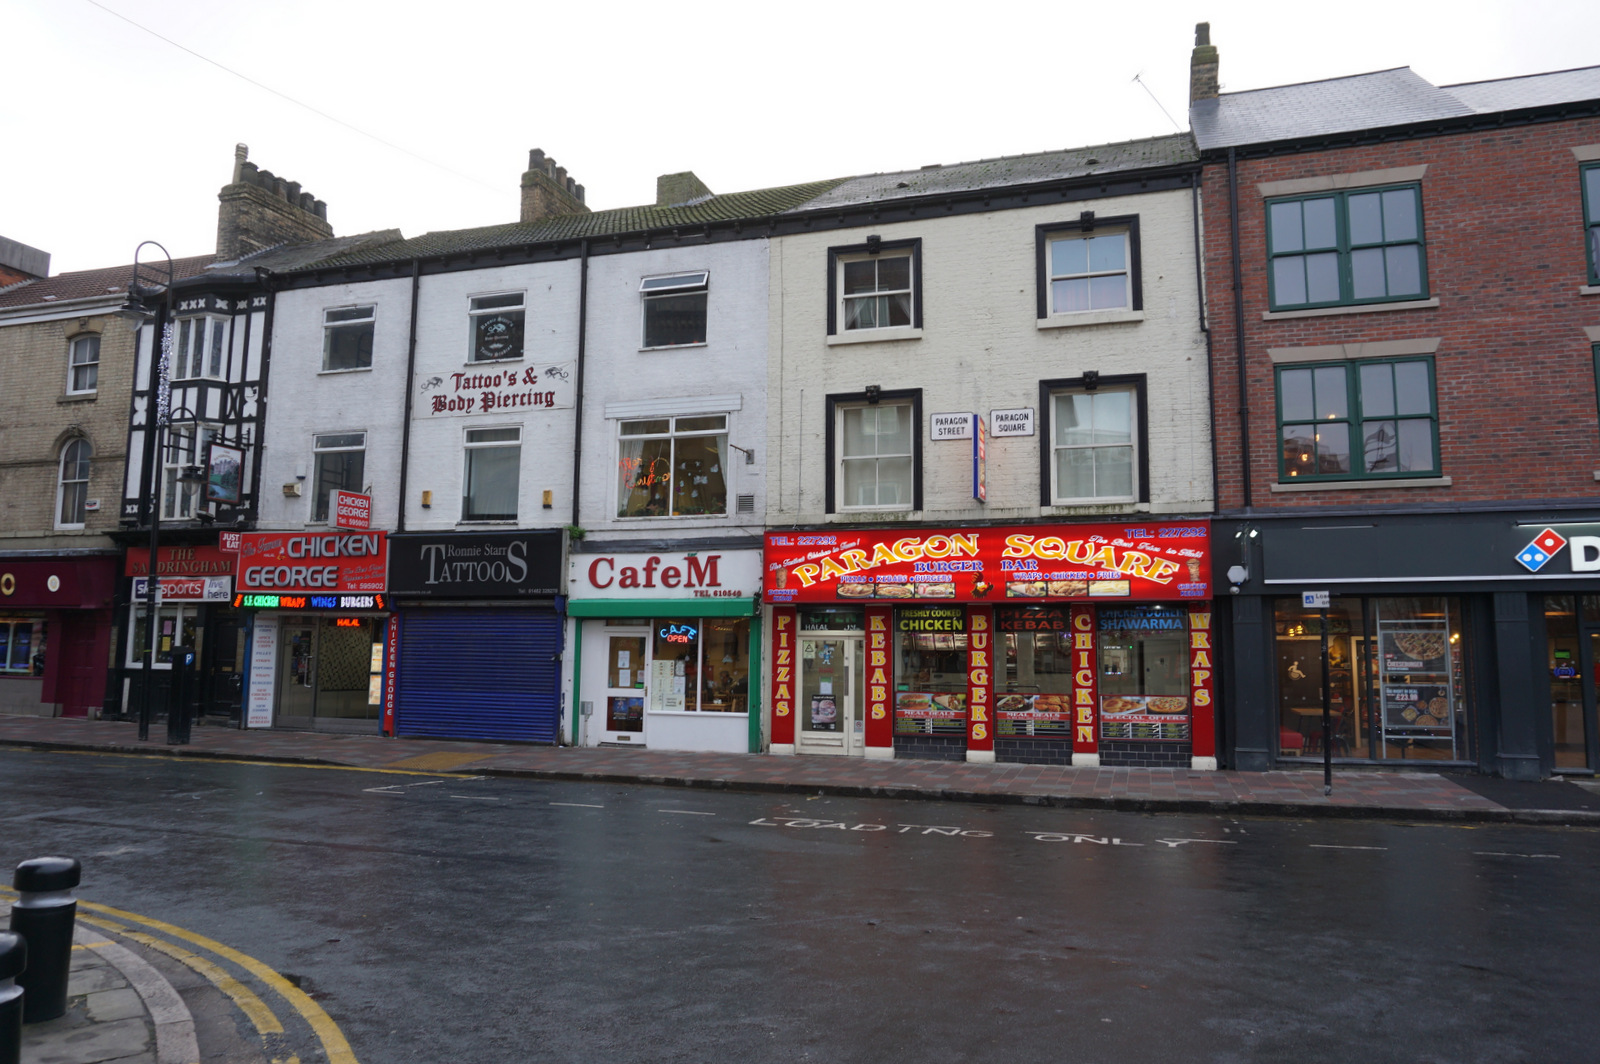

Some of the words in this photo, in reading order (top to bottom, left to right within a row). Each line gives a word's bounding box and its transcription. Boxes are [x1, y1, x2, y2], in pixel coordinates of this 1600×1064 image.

[450, 371, 517, 393] Tattoo's
[522, 366, 538, 385] &
[432, 395, 474, 415] Body
[479, 389, 555, 412] Piercing
[935, 417, 968, 426] PARAGON
[995, 413, 1029, 422] PARAGON
[938, 427, 966, 436] STREET
[999, 423, 1026, 432] SQUARE
[338, 495, 369, 508] CHICKEN
[338, 505, 369, 518] GEORGE
[222, 533, 240, 541] JUST
[1124, 528, 1155, 538] TEL:
[1158, 527, 1207, 538] 227292
[287, 534, 379, 558] CHICKEN
[769, 536, 794, 546] TEL:
[797, 535, 837, 545] 227292
[169, 549, 195, 560] THE
[447, 544, 481, 557] Ronnie
[484, 543, 507, 556] Starr
[420, 540, 528, 585] TATTOOS
[792, 533, 980, 588] PARAGON
[1002, 534, 1180, 584] SQUARE
[914, 560, 984, 573] BURGER
[1001, 559, 1038, 571] BAR
[131, 560, 231, 574] SADRINGHAM
[244, 566, 338, 587] GEORGE
[876, 575, 907, 583] KEBABS
[915, 574, 952, 582] BURGERS
[1096, 571, 1121, 579] FRIES
[161, 582, 202, 597] sports
[208, 579, 223, 589] live
[207, 590, 228, 598] here
[253, 595, 279, 607] CHICKEN
[280, 596, 306, 608] WRAPS
[311, 596, 337, 608] WINGS
[340, 596, 373, 607] BURGERS
[901, 609, 930, 617] FRESHLY
[931, 609, 961, 617] COOKED
[1000, 609, 1064, 618] PIZZA
[899, 619, 963, 631] CHICKEN
[1000, 621, 1065, 629] KEBAB
[1100, 619, 1183, 629] SHAWARMA
[659, 624, 697, 641] CAFE
[389, 616, 397, 668] CHICKEN
[666, 634, 688, 644] OPEN
[1189, 612, 1212, 706] WRAPS
[775, 615, 790, 717] PIZZAS
[870, 615, 888, 720] KEBABS
[970, 614, 989, 741] BURGERS
[1075, 614, 1094, 742] CHICKEN
[386, 671, 395, 716] GEORGE
